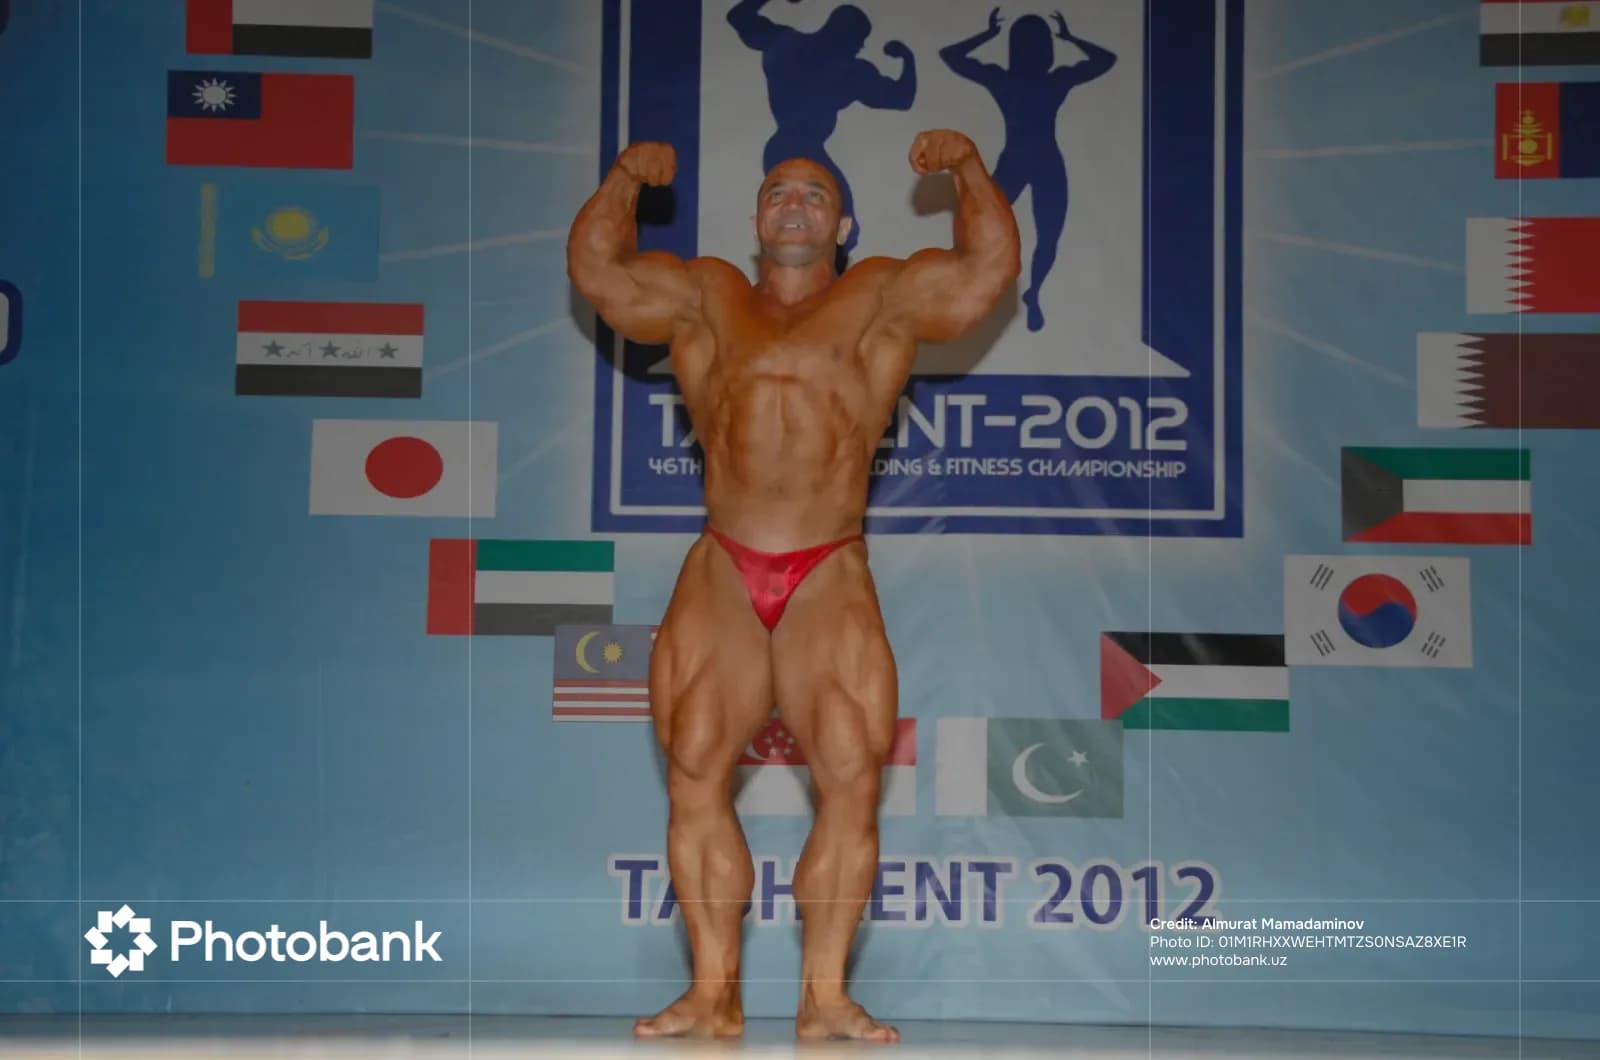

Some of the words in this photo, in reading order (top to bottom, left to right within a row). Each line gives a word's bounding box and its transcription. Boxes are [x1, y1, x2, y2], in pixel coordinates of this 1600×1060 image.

[648, 457, 703, 475] 46TH
[927, 457, 942, 476] &
[946, 457, 1024, 476] FITNESS
[1028, 458, 1187, 478] CHAMPIONSHIP
[614, 860, 1013, 922] THENT
[1033, 863, 1216, 927] 2012
